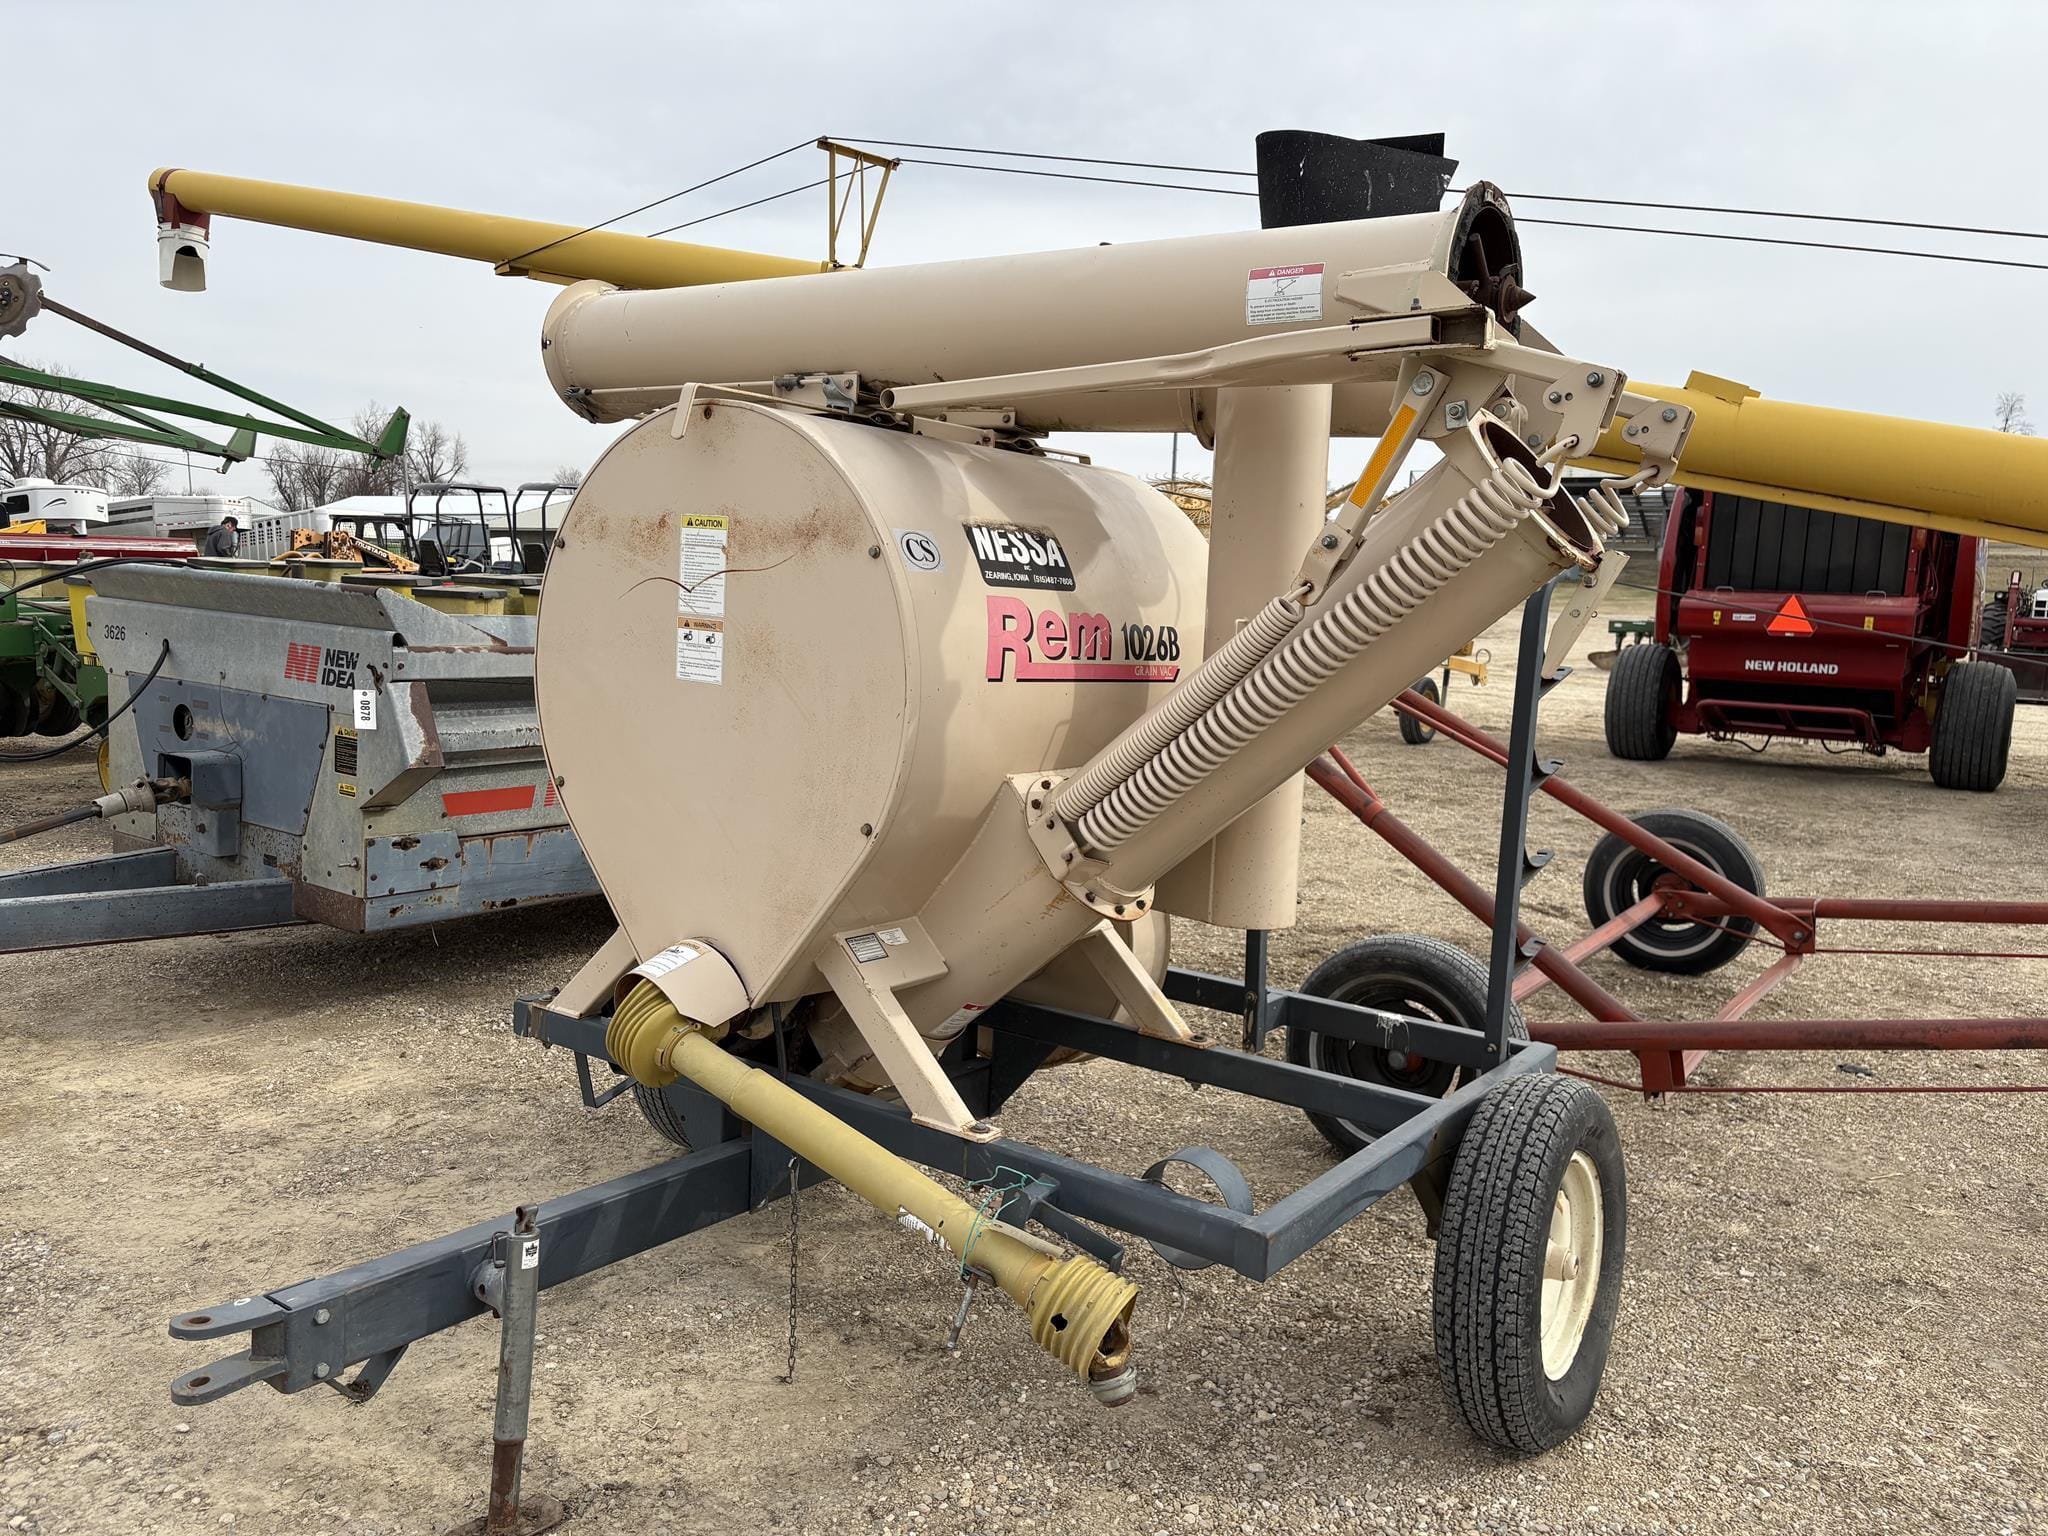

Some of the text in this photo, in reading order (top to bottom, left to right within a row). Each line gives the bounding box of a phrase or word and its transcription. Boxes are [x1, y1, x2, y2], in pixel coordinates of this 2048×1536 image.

[1276, 267, 1305, 276] DANGER
[694, 518, 723, 528] CAUTION
[906, 538, 936, 562] CS
[972, 527, 1065, 568] NESSA
[104, 624, 126, 641] 3626
[693, 621, 717, 630] WARNING
[986, 595, 1181, 682] Rem 1026B
[324, 648, 360, 670] NEW
[1744, 659, 1839, 675] NEW HOLLAND
[321, 667, 356, 690] IDEA
[1135, 665, 1173, 677] GRAIN VAC
[360, 700, 371, 721] 0878
